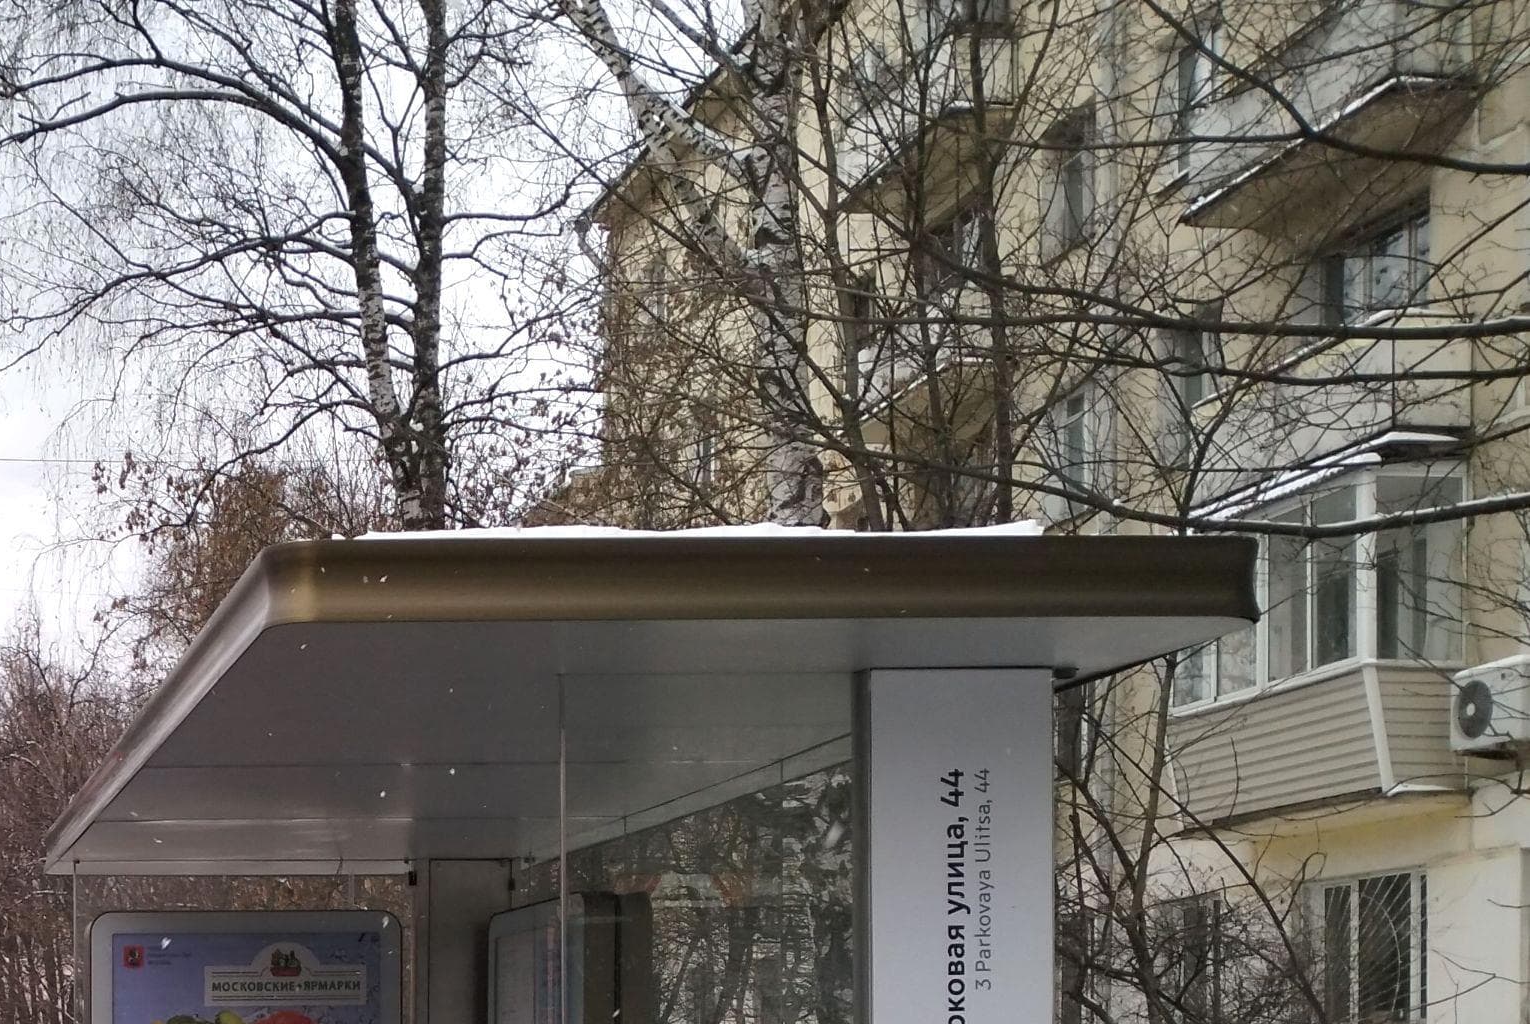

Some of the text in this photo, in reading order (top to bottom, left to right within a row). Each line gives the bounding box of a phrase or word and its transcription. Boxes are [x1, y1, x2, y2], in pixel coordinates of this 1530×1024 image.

[940, 768, 965, 807] 44
[947, 816, 971, 915] улица,
[973, 768, 995, 991] 3 Parkovaya Ulitsa, 44
[211, 980, 361, 993] МОСКОВСКИЕ ЯРМАРКИ
